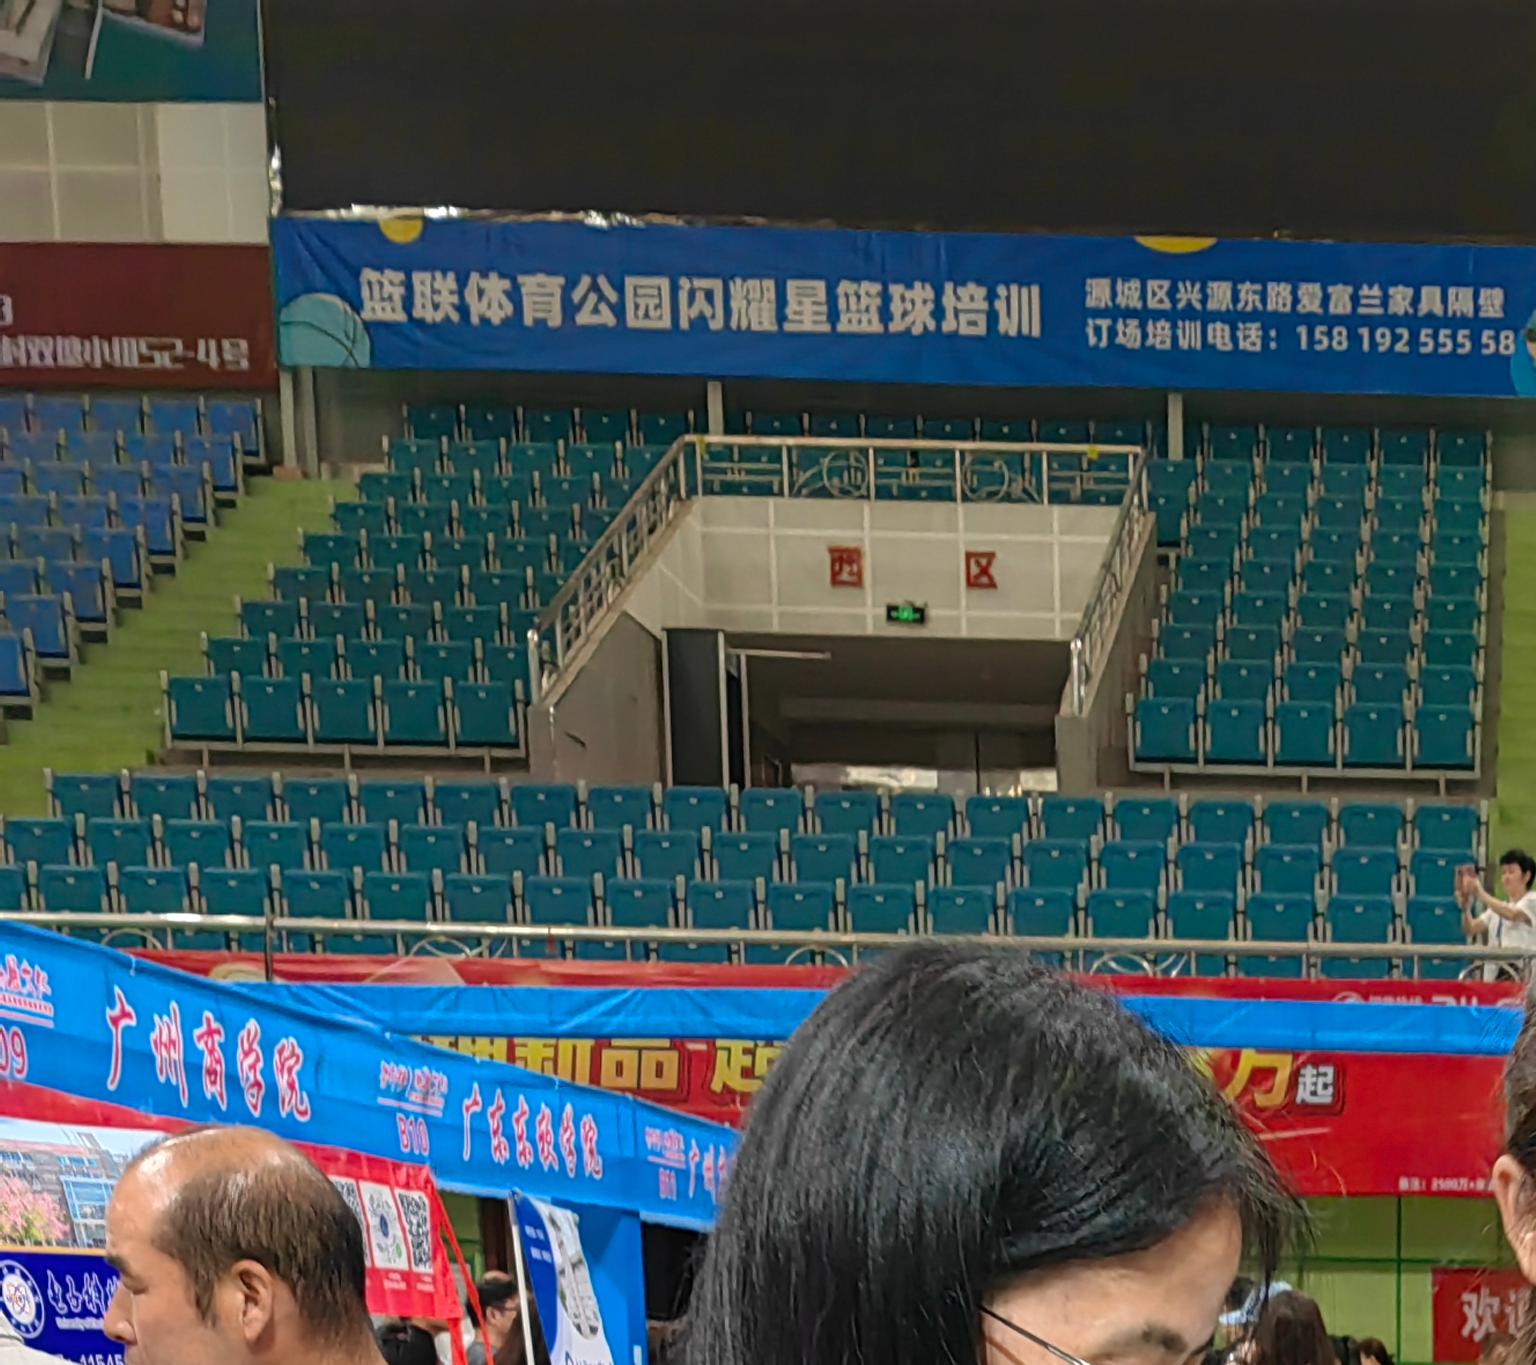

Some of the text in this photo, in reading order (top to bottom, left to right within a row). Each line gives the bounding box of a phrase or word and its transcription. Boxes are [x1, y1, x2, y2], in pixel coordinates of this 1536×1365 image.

[359, 267, 1041, 338] 篮联体育公园闪耀星篮球培训
[1085, 277, 1505, 319] 源城区兴源东路爱富兰家具隔壁
[1296, 324, 1349, 352] 158
[1360, 327, 1410, 353] 192
[1418, 328, 1473, 355] 555
[1480, 329, 1516, 355] 58
[106, 984, 311, 1122] 广州商学院
